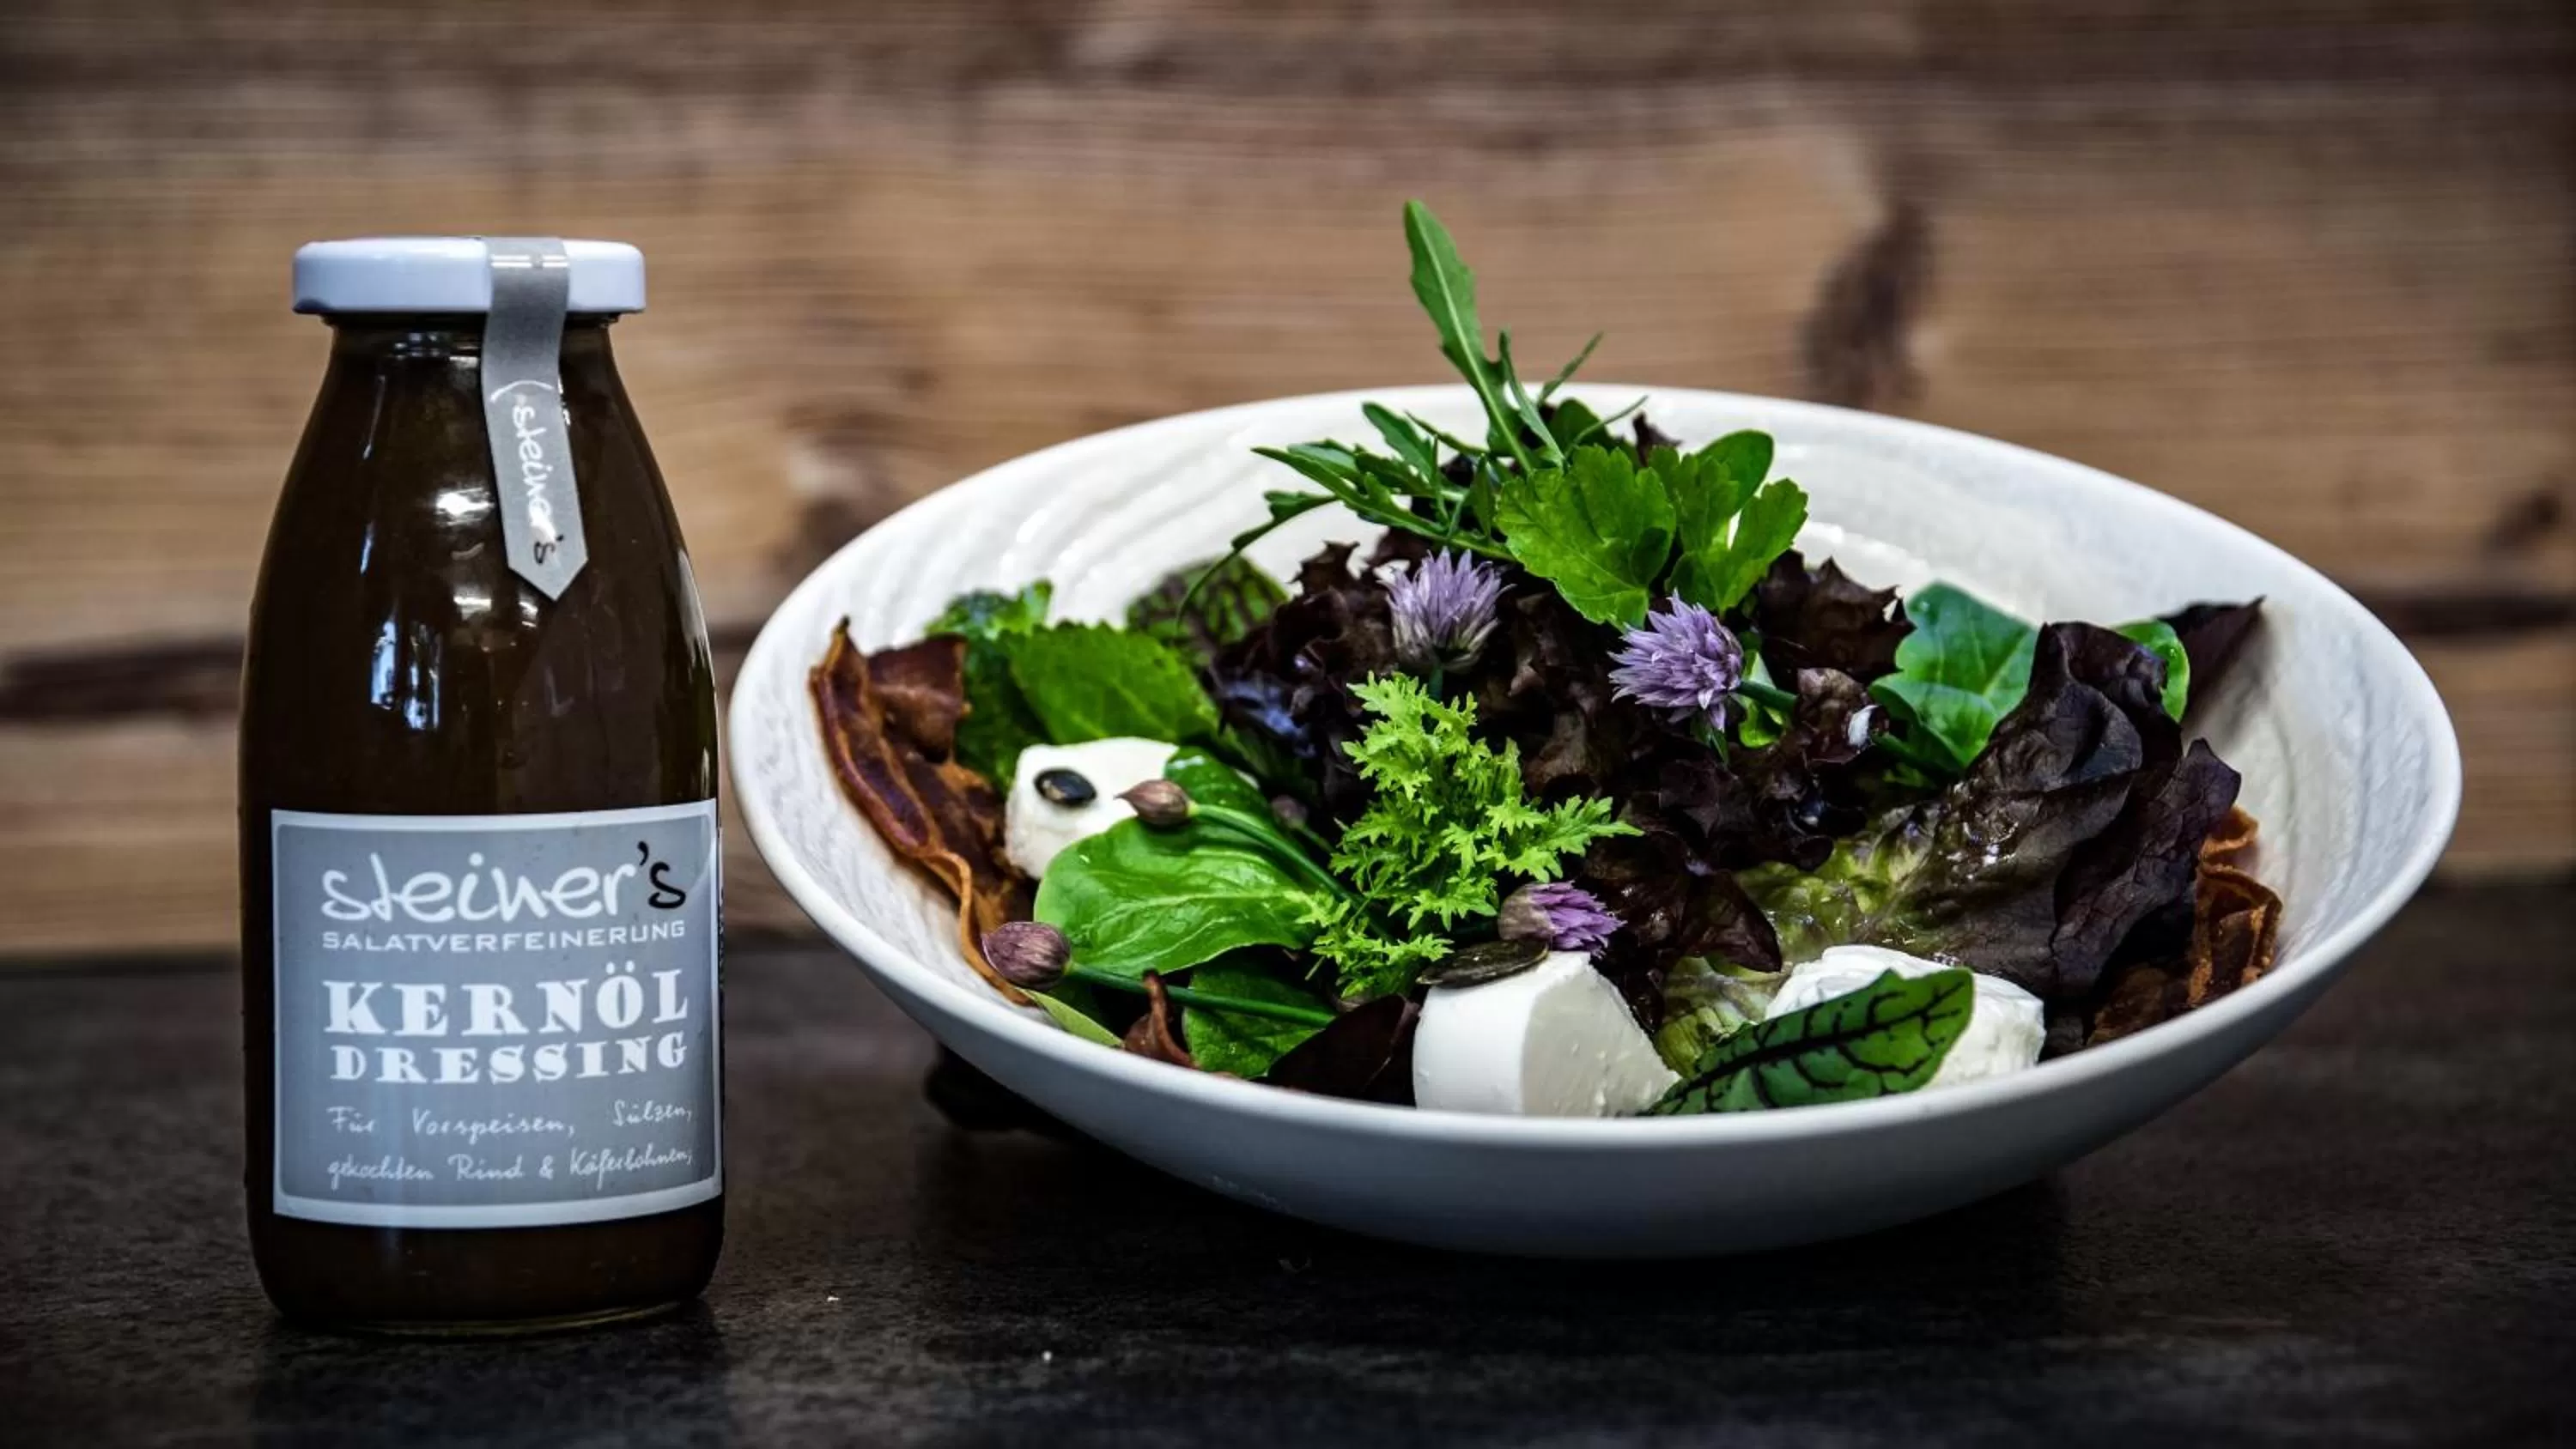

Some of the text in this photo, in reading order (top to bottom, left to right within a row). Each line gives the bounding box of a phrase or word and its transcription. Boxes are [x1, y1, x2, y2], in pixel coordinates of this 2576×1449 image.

[321, 840, 687, 923] steiner's
[321, 919, 685, 952] SALATVERFEINERUNG
[322, 960, 688, 1037] KERNÖL
[330, 1031, 687, 1084] DRESSING
[325, 1099, 692, 1145] Für Vorspeisen, Sülzen,
[447, 1153, 526, 1182] Rind
[538, 1155, 554, 1180] &
